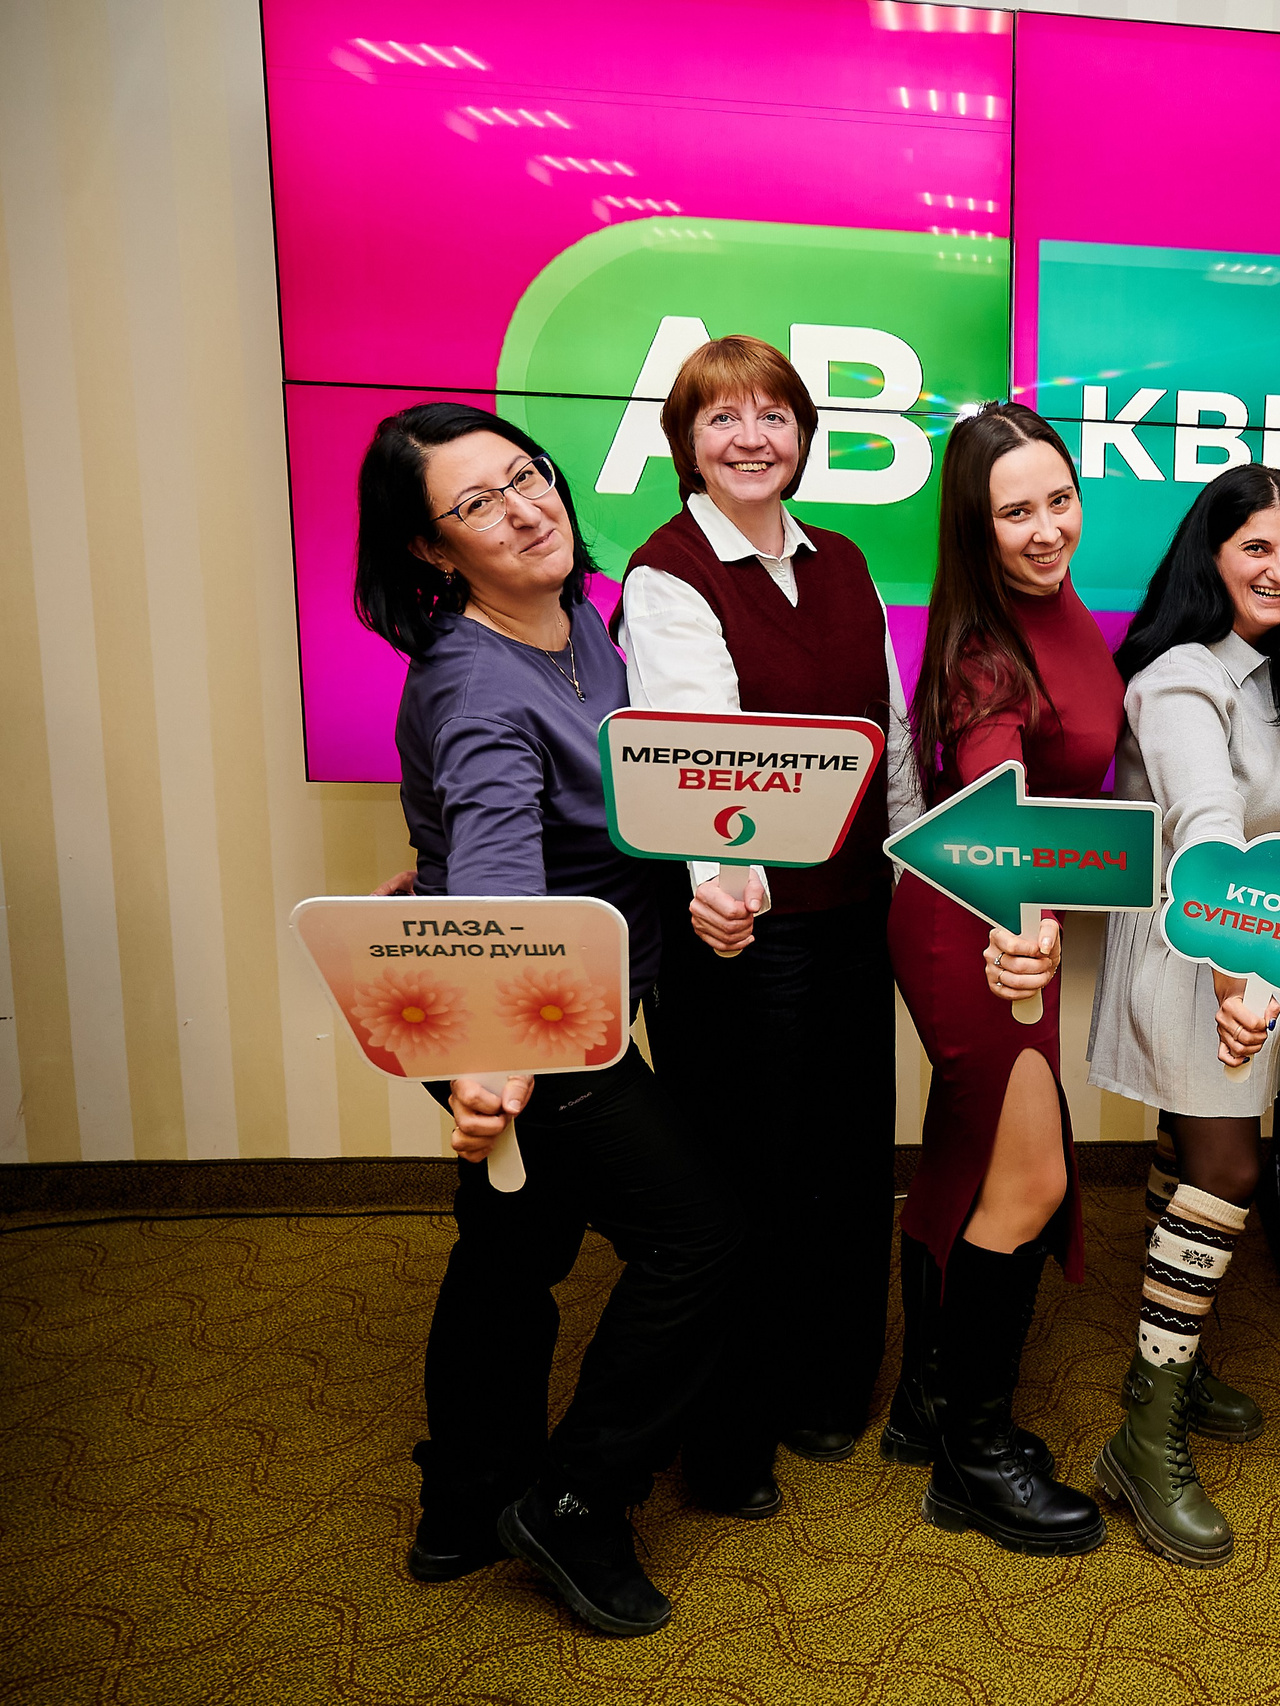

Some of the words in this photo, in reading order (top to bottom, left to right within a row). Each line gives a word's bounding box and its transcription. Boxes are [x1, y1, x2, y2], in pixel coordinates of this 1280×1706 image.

[622, 746, 859, 772] МЕРОПРИЯТИЕ
[677, 768, 803, 793] ВЕКА!
[943, 844, 1127, 871] ТОП-ВРАЧ
[402, 920, 505, 937] ГЛАЗА
[369, 943, 485, 958] ЗЕРКАЛО
[489, 943, 566, 959] ДУШИ
